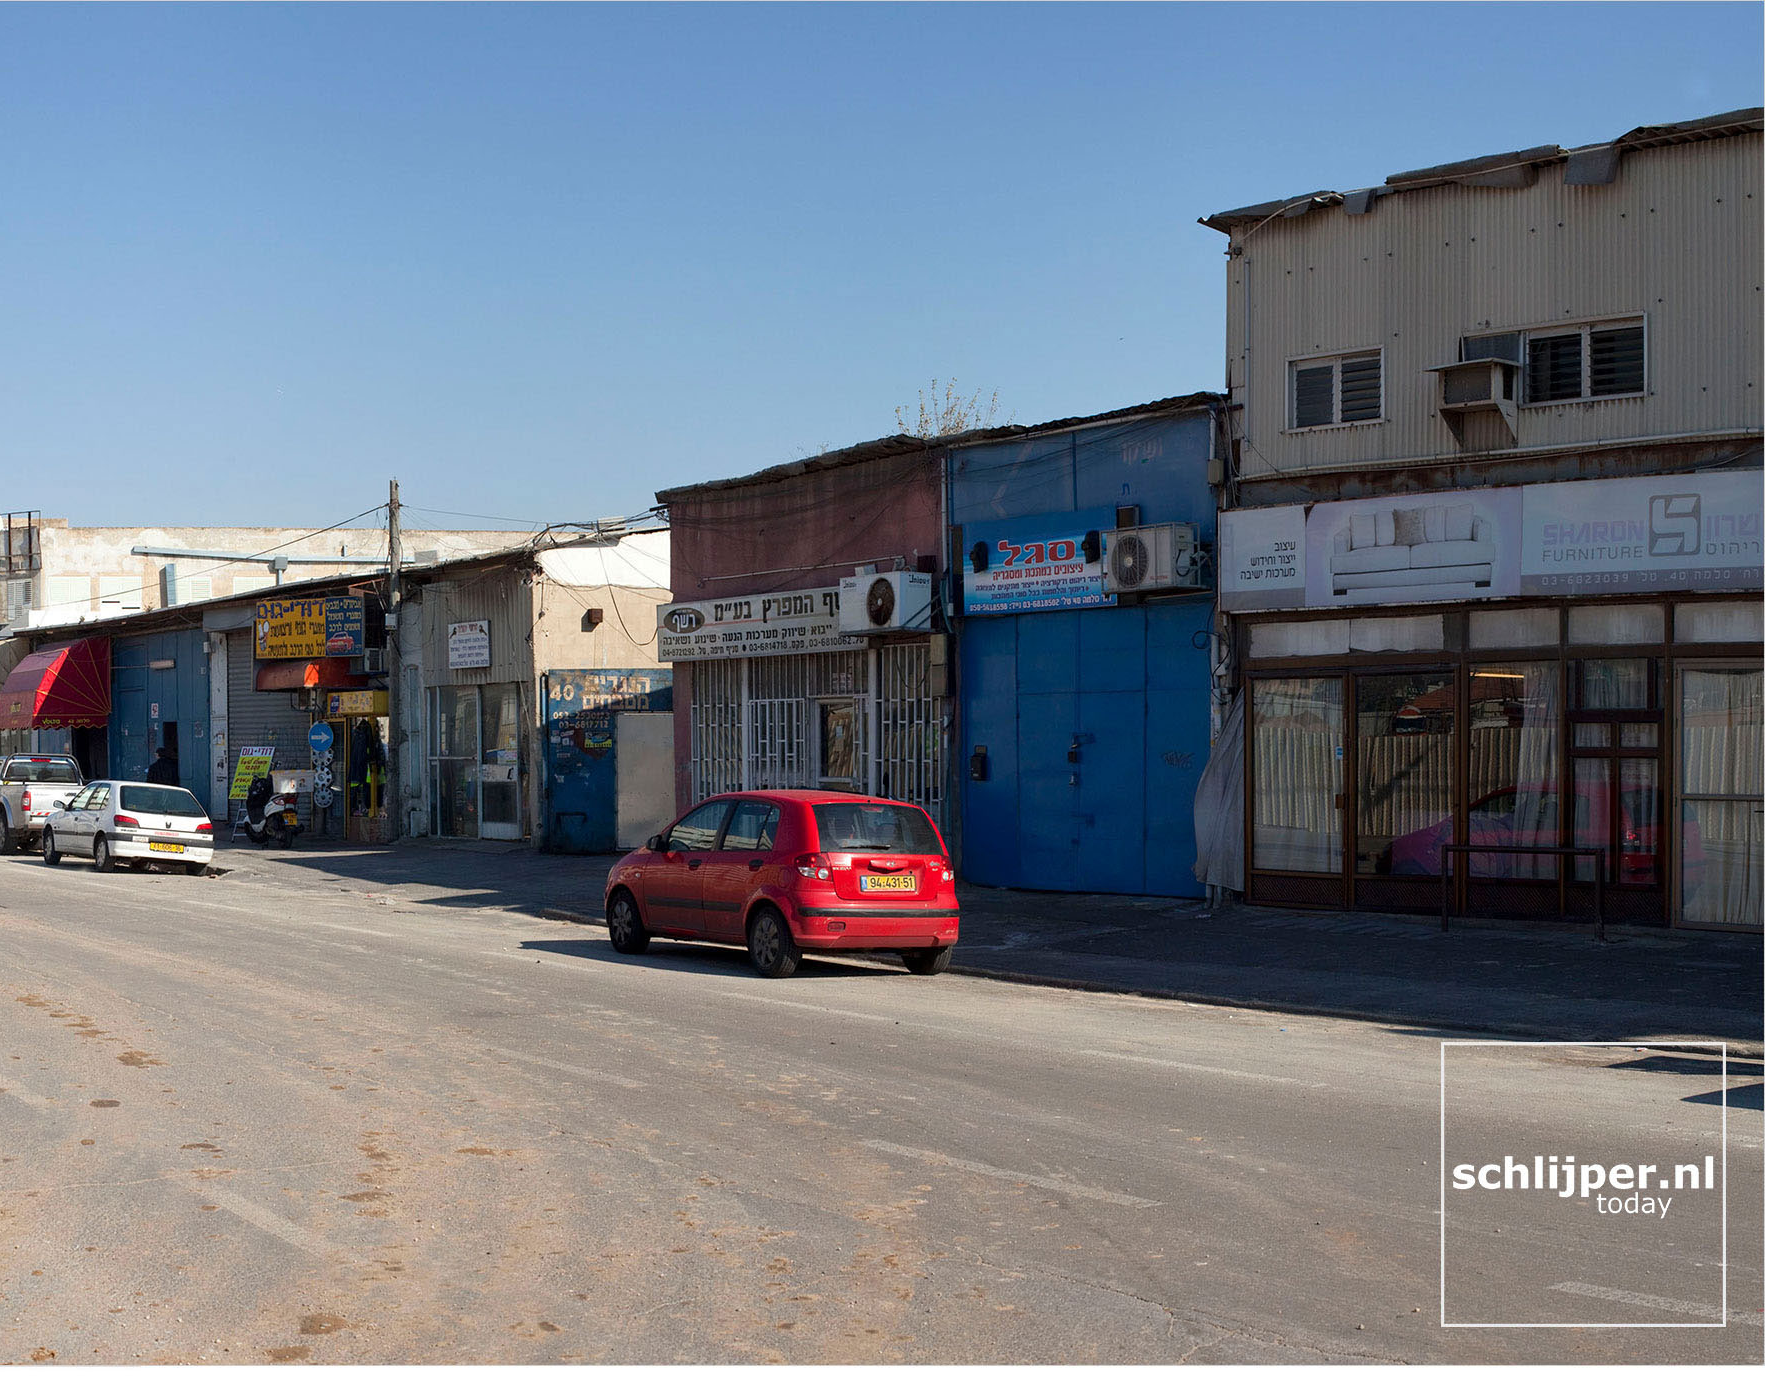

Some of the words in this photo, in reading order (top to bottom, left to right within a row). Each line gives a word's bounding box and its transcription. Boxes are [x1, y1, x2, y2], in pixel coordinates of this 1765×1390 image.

[1542, 520, 1645, 546] SHARON
[1706, 513, 1759, 540] שרון
[998, 540, 1076, 567] סגל
[1274, 541, 1296, 552] עיצוב
[1542, 546, 1644, 562] FURNITURE
[1705, 541, 1760, 556] ריהוט
[1240, 571, 1263, 580] ישיבה
[1265, 567, 1296, 579] מערכות
[1541, 573, 1629, 586] 03-6823039
[762, 594, 814, 623] המפרץ
[672, 613, 696, 633] רשף
[746, 628, 779, 641] מערכות
[550, 685, 574, 701] 40
